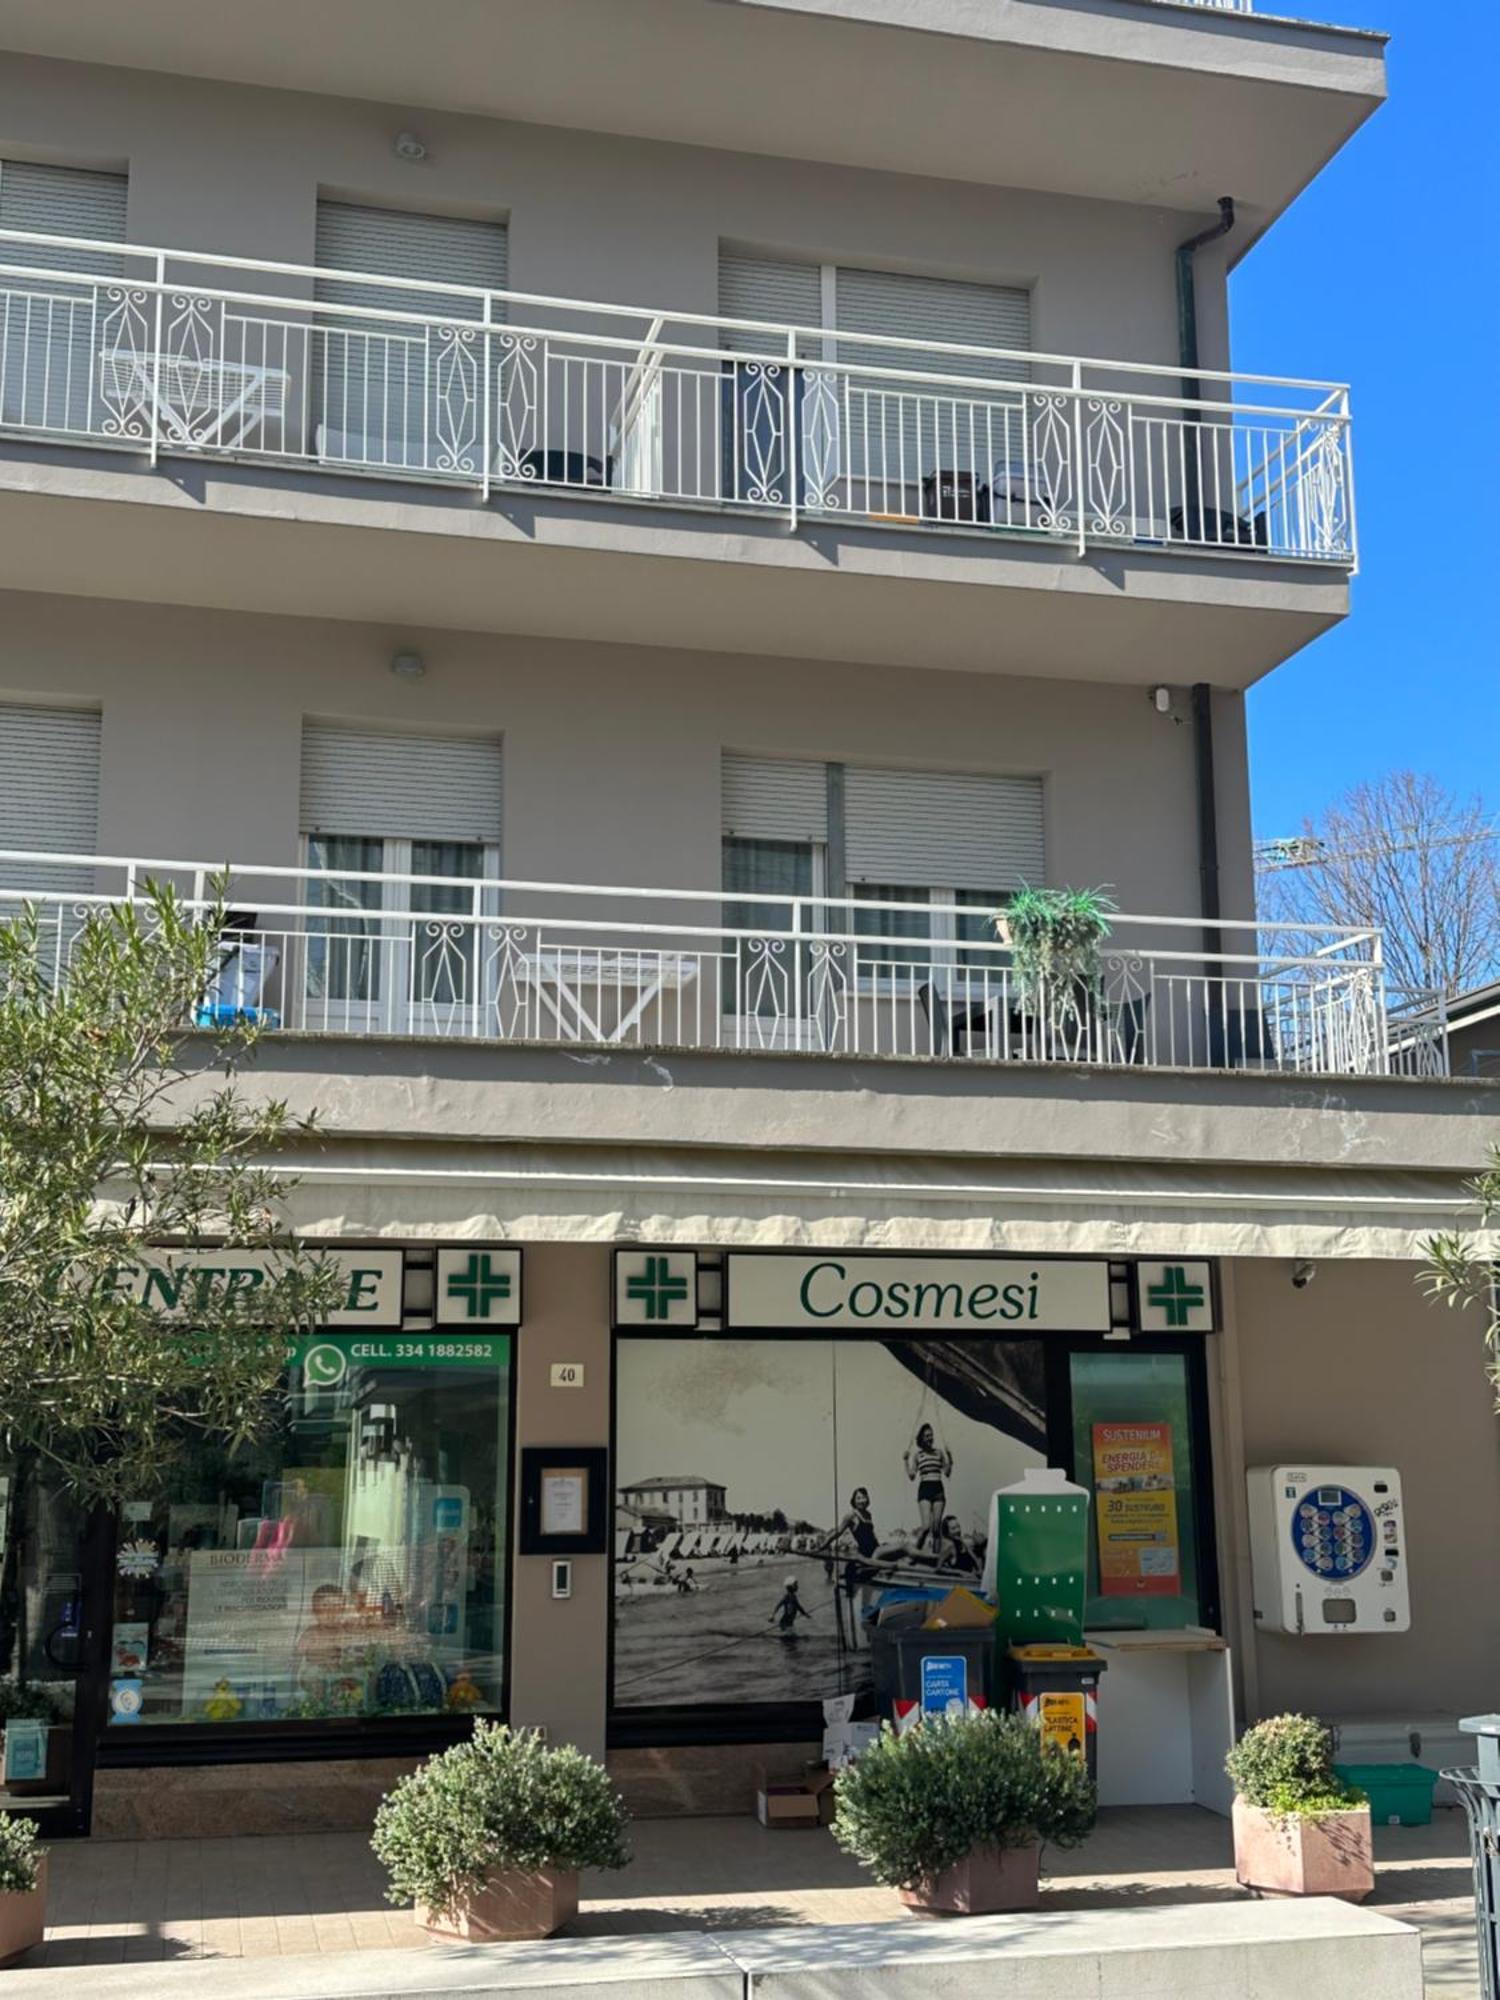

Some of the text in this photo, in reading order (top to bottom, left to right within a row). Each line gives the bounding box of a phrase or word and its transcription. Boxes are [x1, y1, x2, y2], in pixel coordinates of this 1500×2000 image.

[43, 1263, 383, 1312] CENTRE
[800, 1262, 1039, 1320] Cosmesi
[350, 1343, 492, 1357] CELL. 334 1882582
[559, 1367, 575, 1382] 40
[1103, 1429, 1161, 1441] SUSTENIUM
[1102, 1451, 1147, 1464] ENERGIA
[1107, 1499, 1123, 1513] 30
[926, 1679, 949, 1688] CARTA
[926, 1687, 960, 1697] CARTONE
